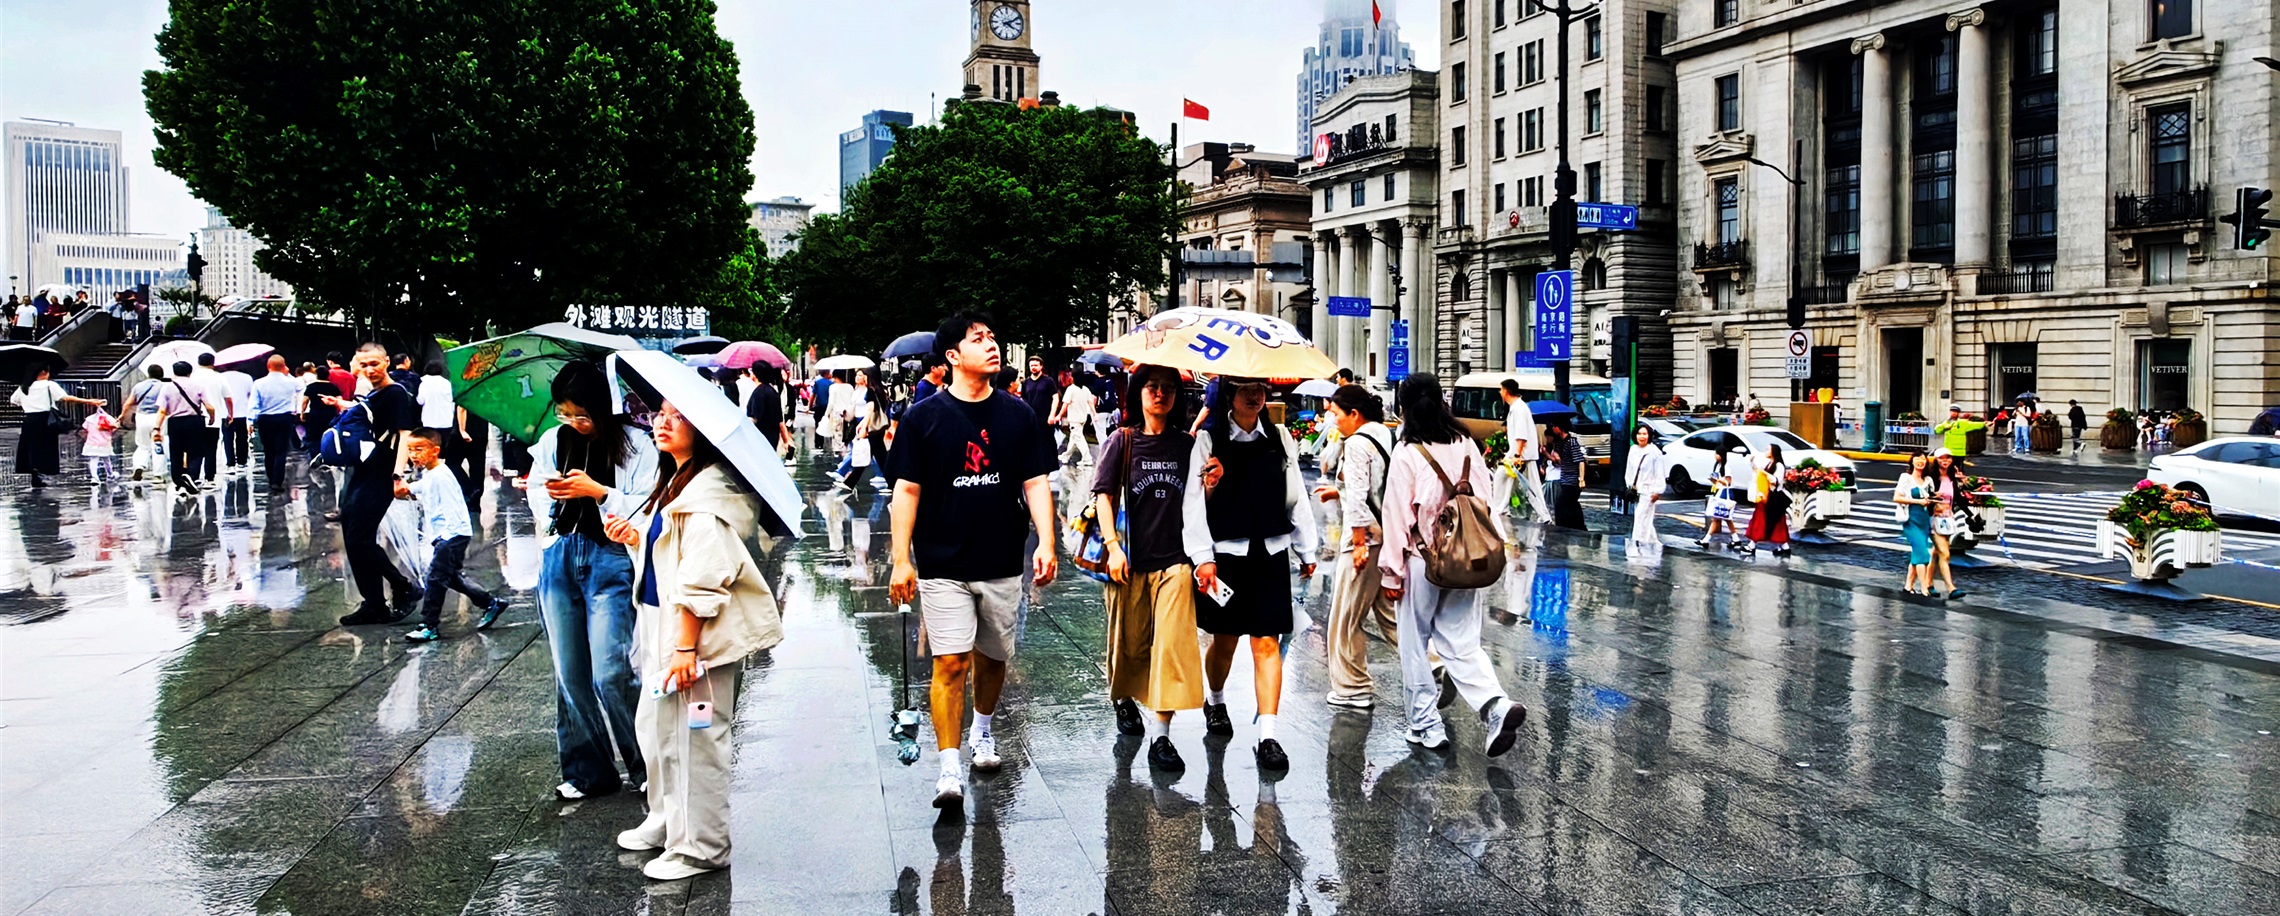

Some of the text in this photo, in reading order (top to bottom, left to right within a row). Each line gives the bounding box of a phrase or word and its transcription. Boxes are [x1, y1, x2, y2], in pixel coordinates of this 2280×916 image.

[564, 303, 707, 330] 外滩观光隧道
[1541, 312, 1565, 322] 南京路
[1541, 323, 1565, 334] 步行街
[2150, 366, 2188, 374] VETIVER
